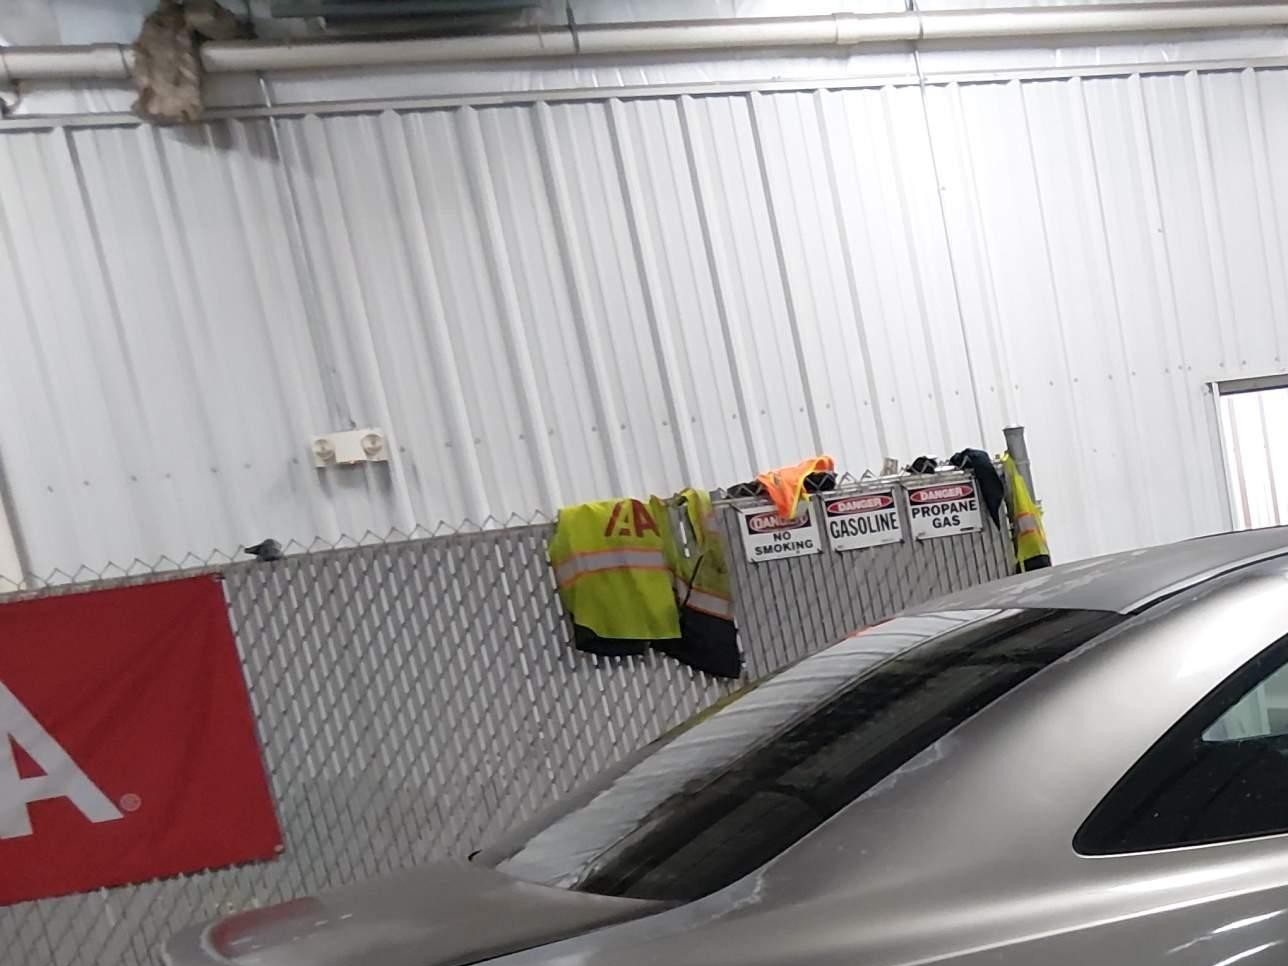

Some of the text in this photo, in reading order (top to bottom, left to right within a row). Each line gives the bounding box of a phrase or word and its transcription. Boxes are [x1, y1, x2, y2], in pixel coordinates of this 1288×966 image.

[921, 486, 962, 501] DANGER
[837, 497, 882, 513] DANGER
[911, 499, 978, 519] PROPANE
[830, 512, 899, 539] GASOLINE
[932, 515, 961, 529] GAS
[773, 531, 792, 542] NO
[755, 539, 814, 555] SMOKING
